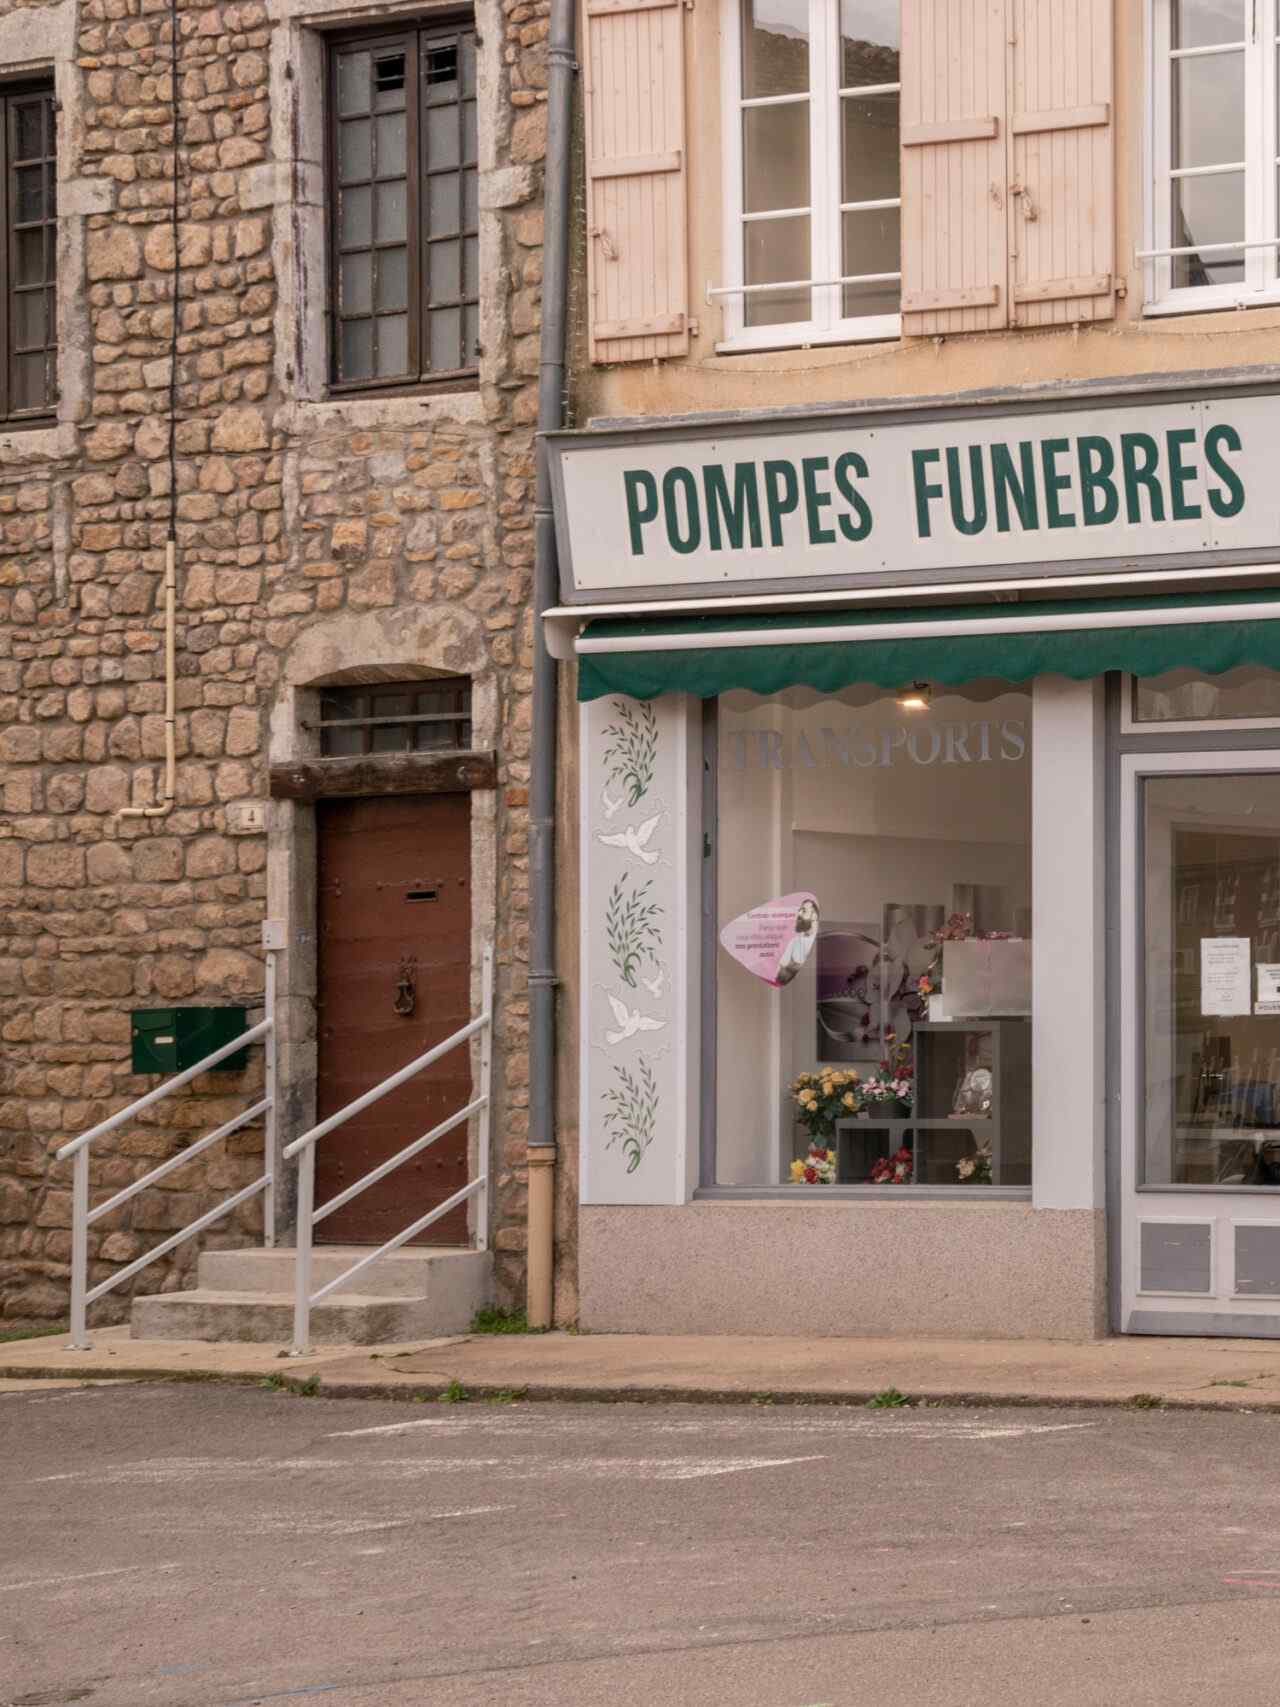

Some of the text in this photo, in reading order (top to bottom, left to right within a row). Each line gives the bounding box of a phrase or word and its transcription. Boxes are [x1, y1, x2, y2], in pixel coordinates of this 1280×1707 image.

[623, 451, 873, 556] POMPES
[911, 424, 1246, 538] FUNEBRES
[727, 719, 1026, 769] TRANSPORTS
[246, 809, 256, 824] 4
